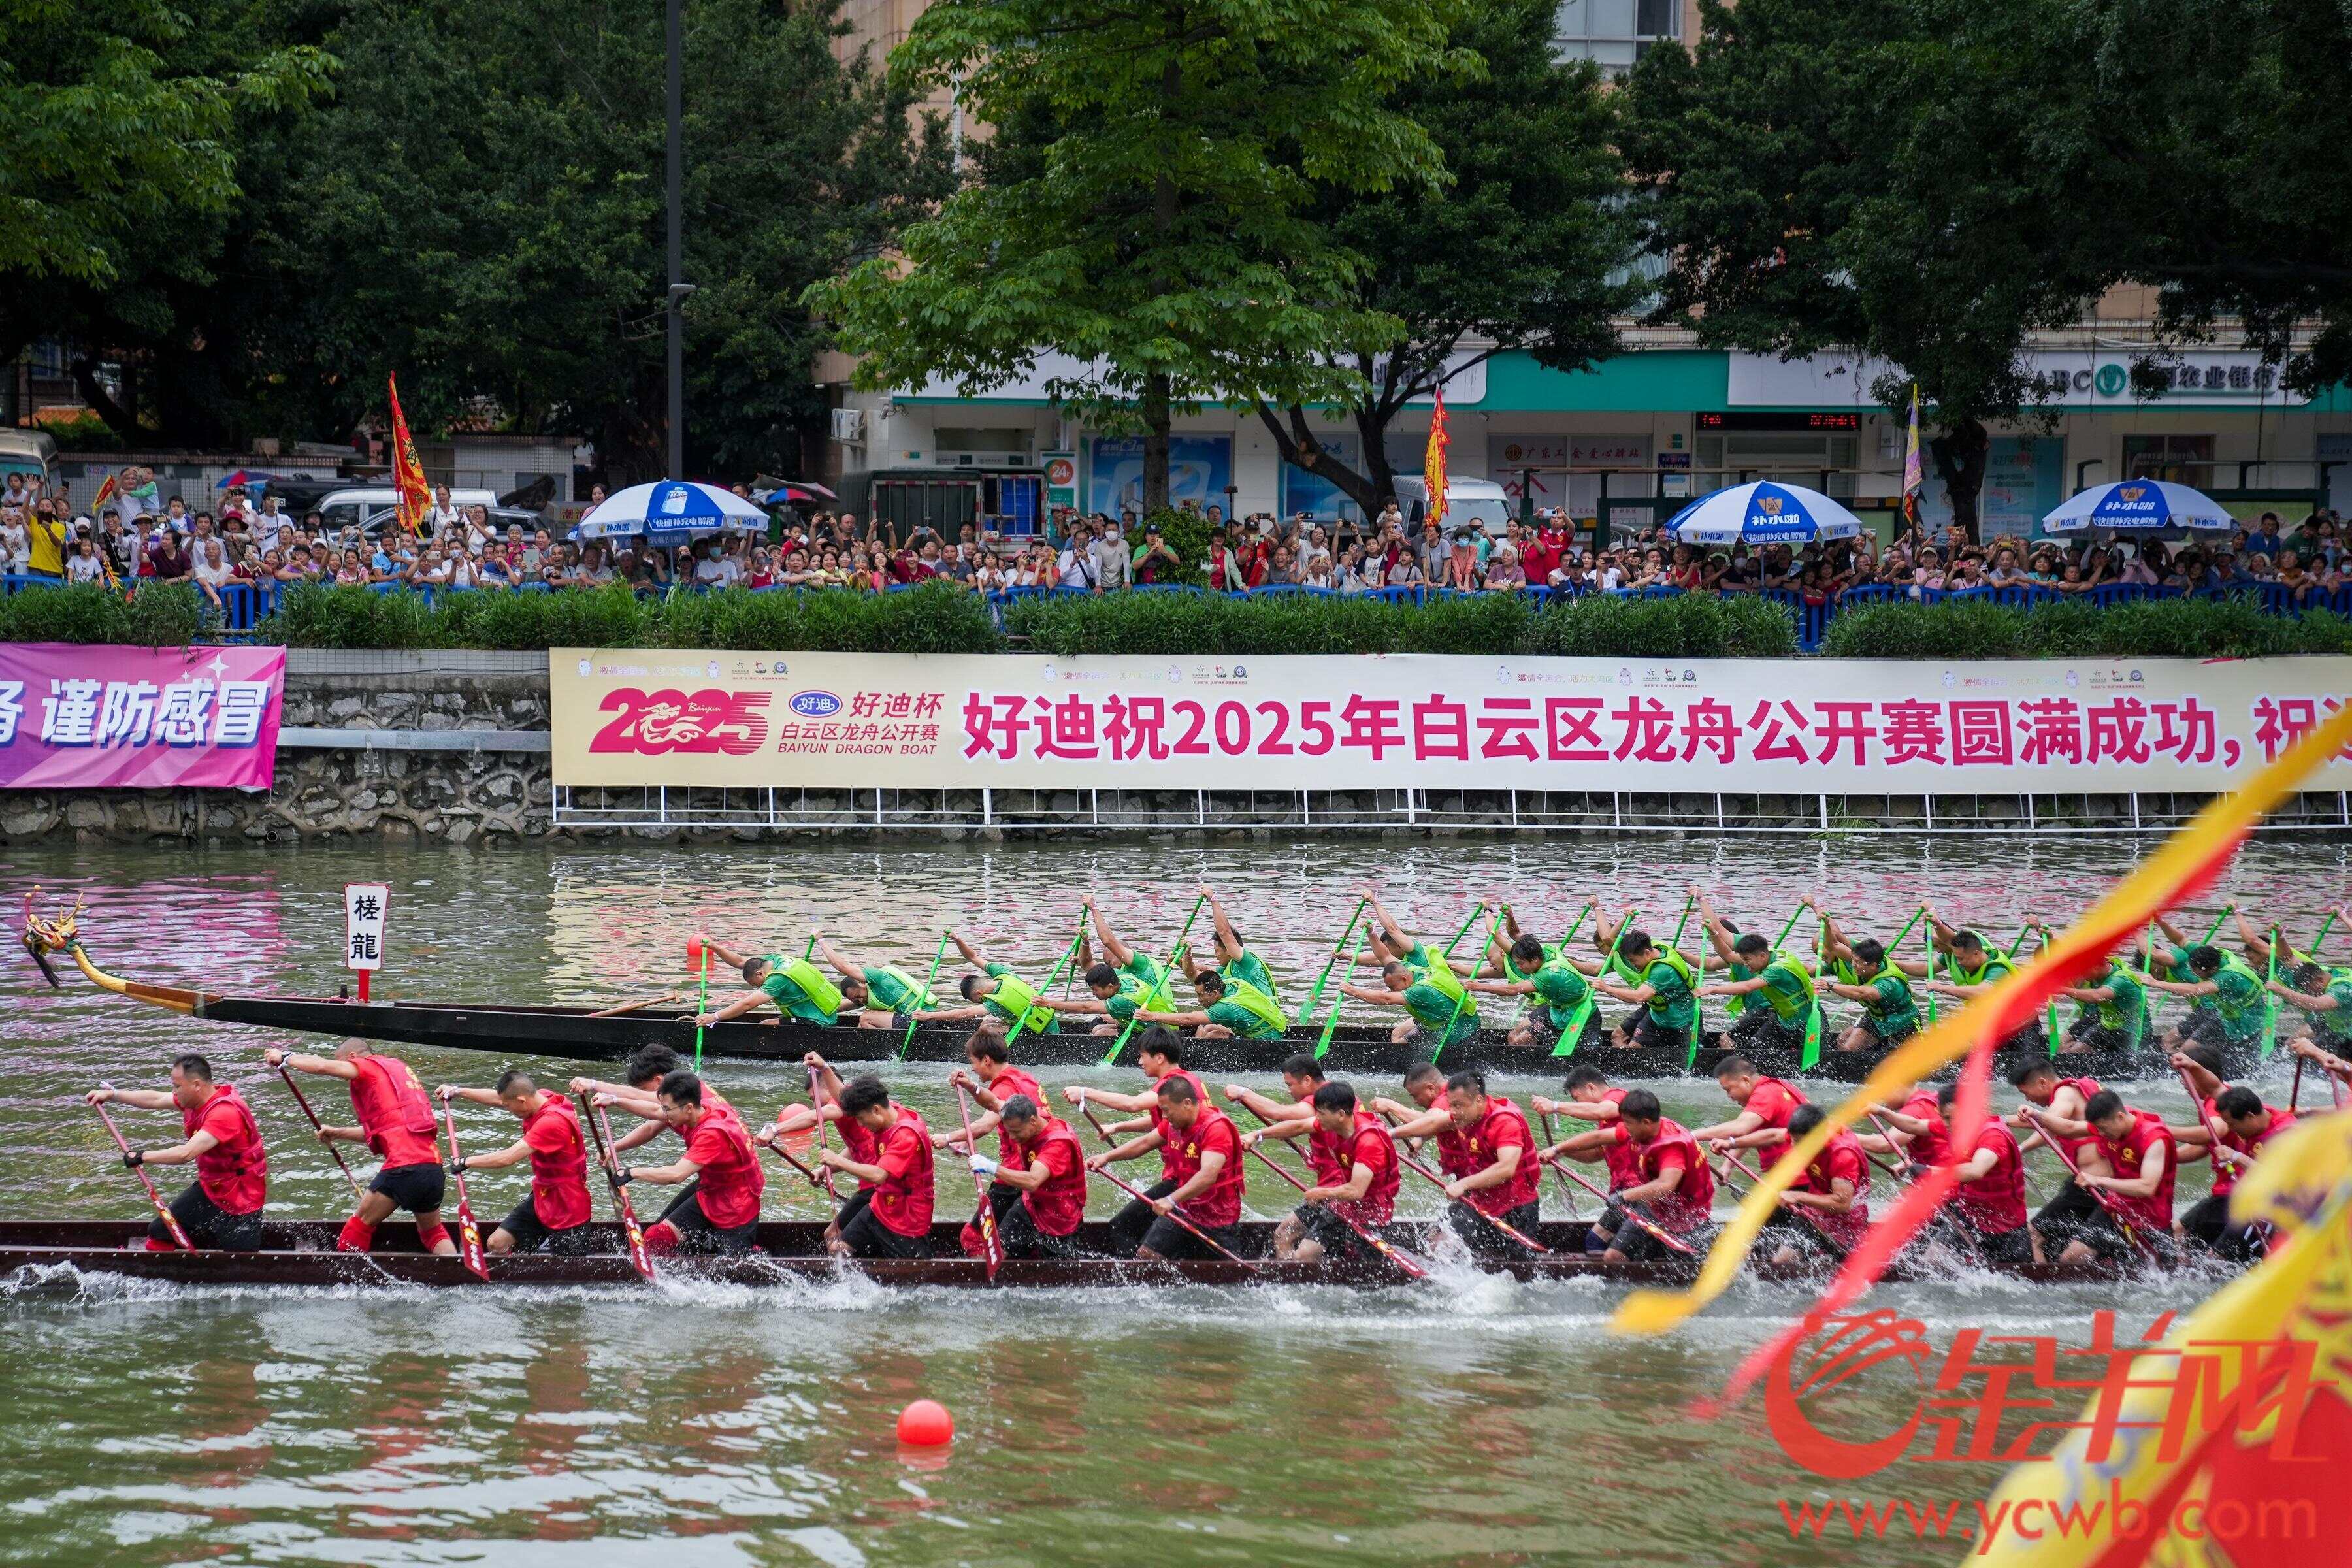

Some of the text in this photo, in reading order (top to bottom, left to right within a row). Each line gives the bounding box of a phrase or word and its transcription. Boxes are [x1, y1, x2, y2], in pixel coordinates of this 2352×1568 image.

[2132, 365, 2277, 389] 农业银行
[2105, 502, 2156, 510] 补水啦
[655, 517, 716, 528] 快速补充电解质
[1752, 514, 1801, 526] 补水啦
[606, 523, 630, 532] 补水啦
[687, 702, 722, 713] Baiyun
[798, 696, 835, 712] 好迪
[849, 691, 945, 719] 好迪杯
[41, 678, 270, 744] 谨防感冒
[781, 721, 940, 742] 白云区龙舟公开赛
[777, 742, 937, 755] BAIYUN DRAGON BOAT
